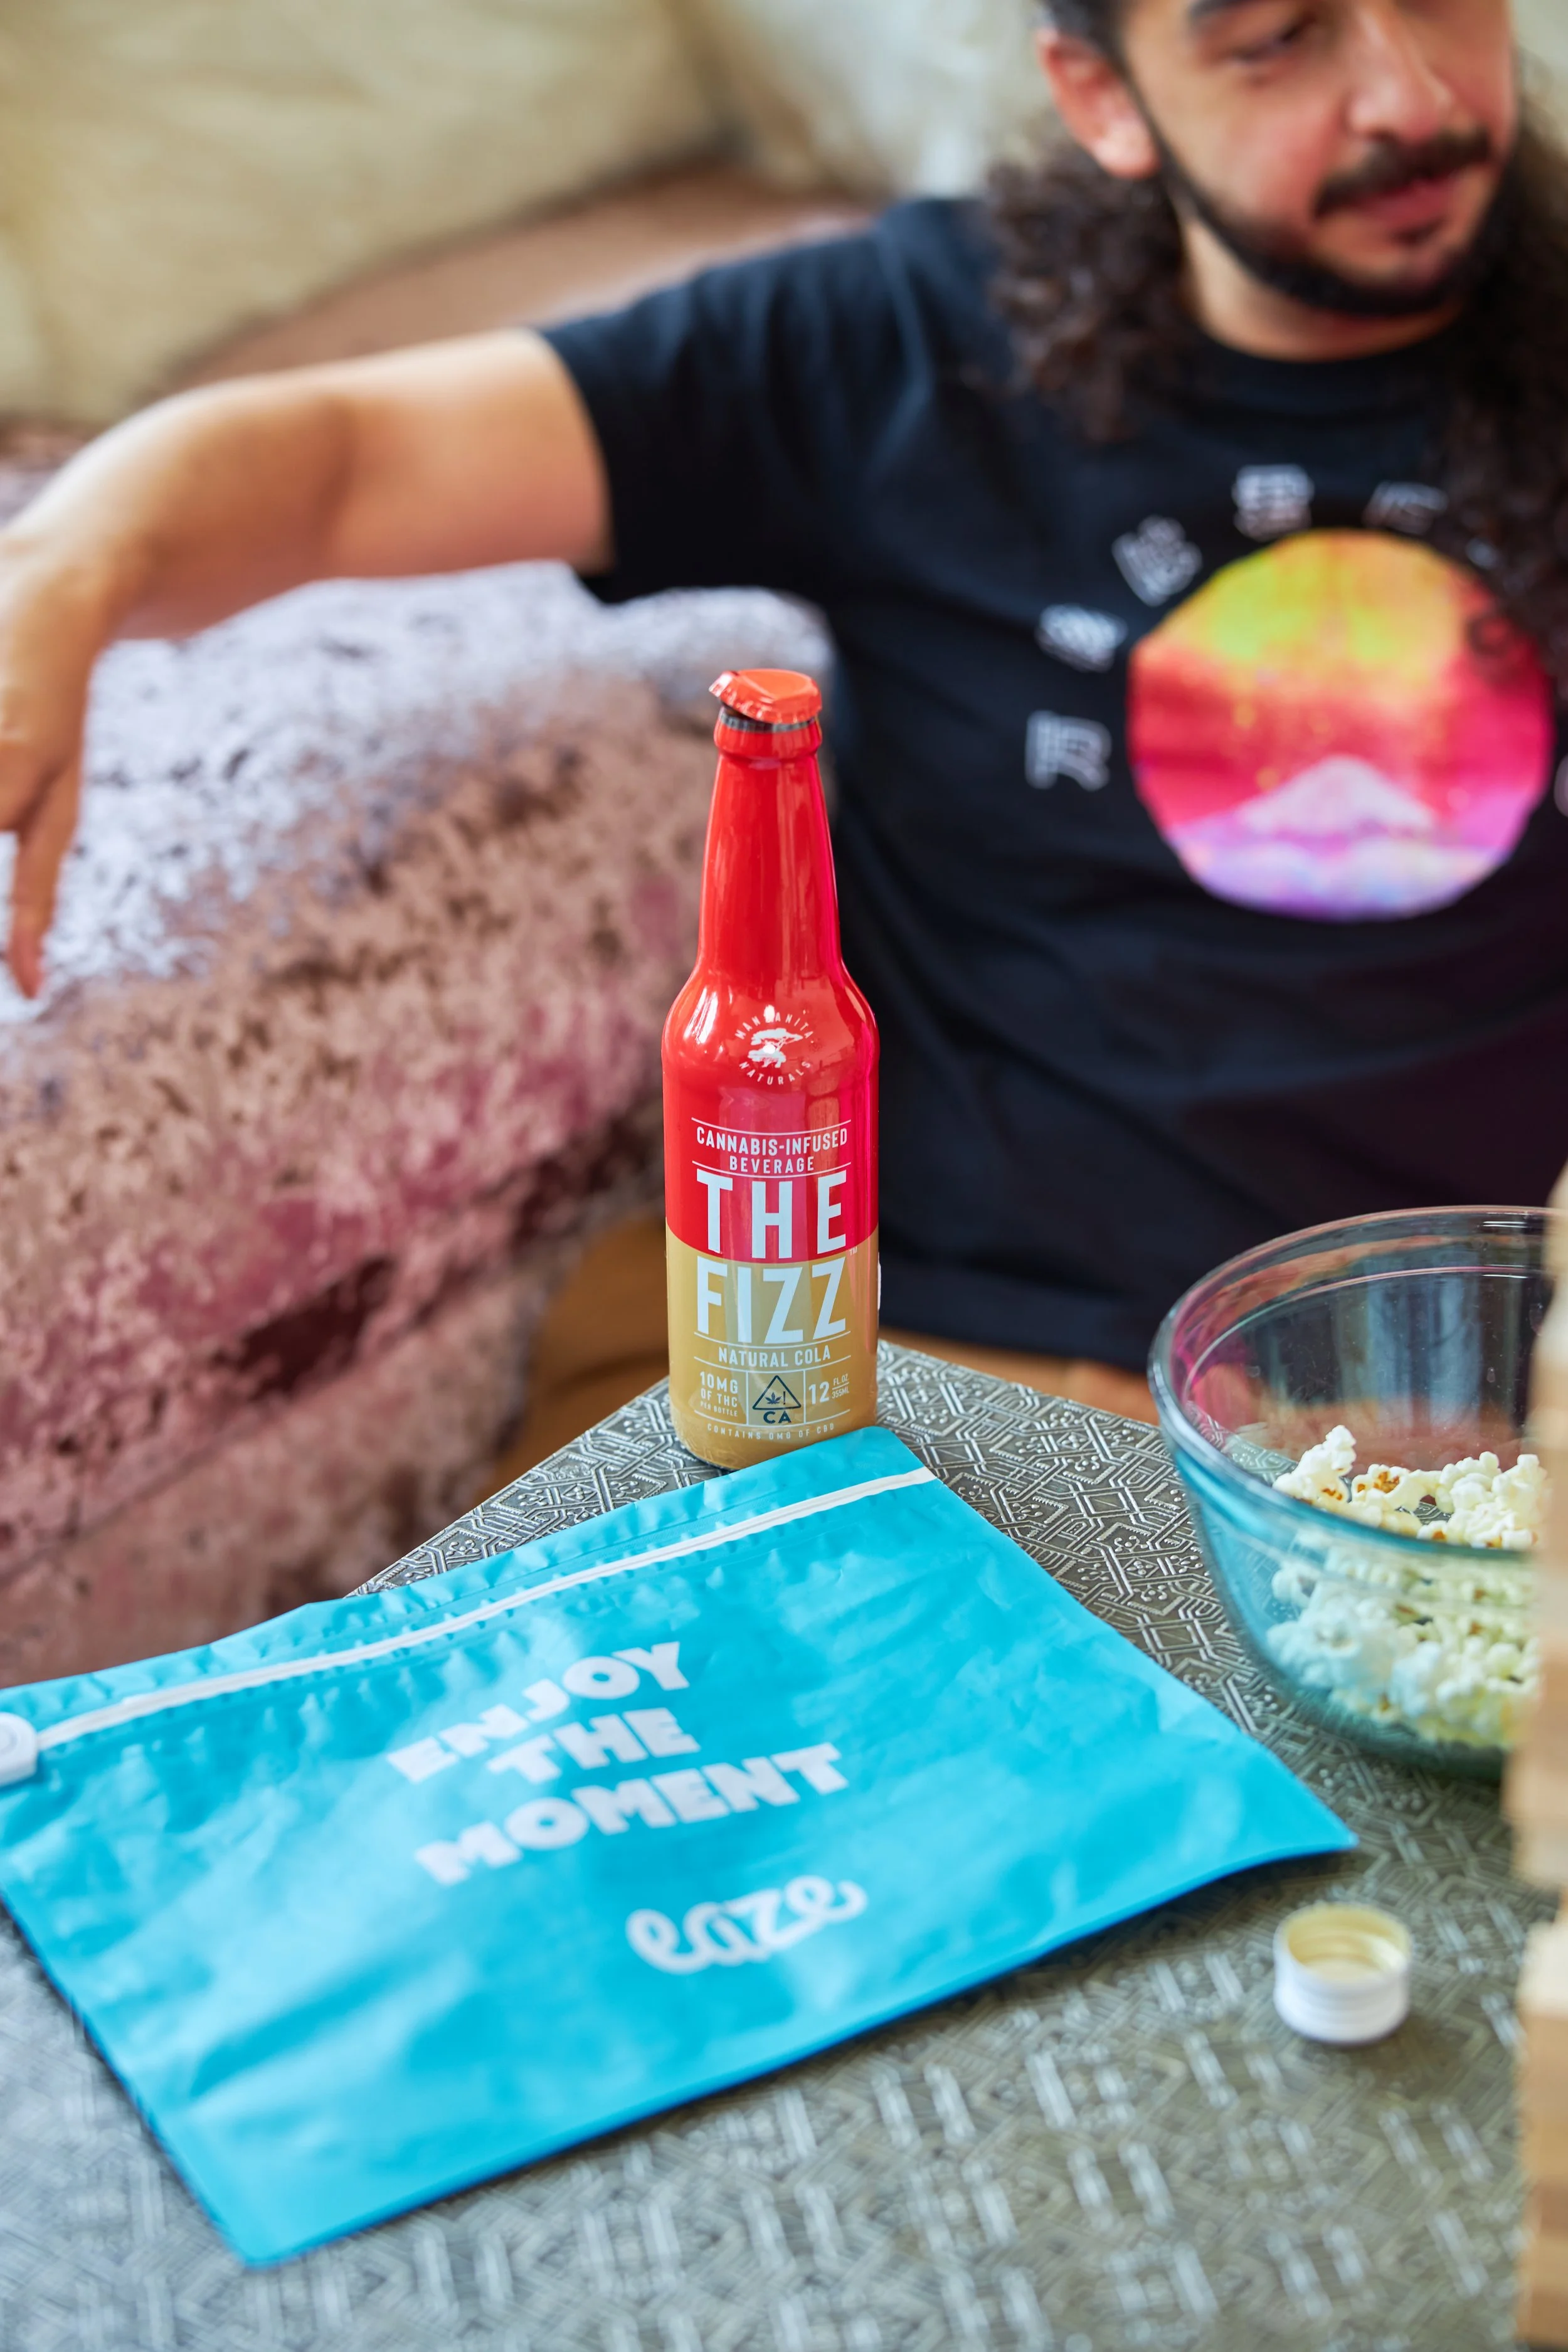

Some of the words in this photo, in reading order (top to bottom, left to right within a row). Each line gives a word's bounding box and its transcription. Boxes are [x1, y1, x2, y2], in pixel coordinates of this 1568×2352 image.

[735, 1011, 813, 1039] MANANITA
[739, 1061, 810, 1085] NATURALS
[697, 1126, 847, 1155] CANNABIS-INFUSED
[729, 1155, 814, 1173] BEVERAGE
[697, 1168, 846, 1259] THE
[697, 1256, 845, 1344] FIZZ
[719, 1347, 788, 1367] NATURAL
[795, 1345, 830, 1366] COLA
[700, 1371, 738, 1394] 10MG
[808, 1381, 829, 1405] 12
[701, 1388, 712, 1401] OF
[717, 1393, 738, 1407] THC
[701, 1401, 711, 1411] PER
[714, 1406, 738, 1417] BOTTLE
[763, 1411, 792, 1424] CA
[707, 1423, 761, 1439] CONTAINS
[799, 1429, 810, 1438] OF
[817, 1422, 834, 1434] CBD
[386, 1641, 689, 1783] ENJOY
[487, 1707, 701, 1783] THE
[415, 1742, 849, 1885] MOMENT
